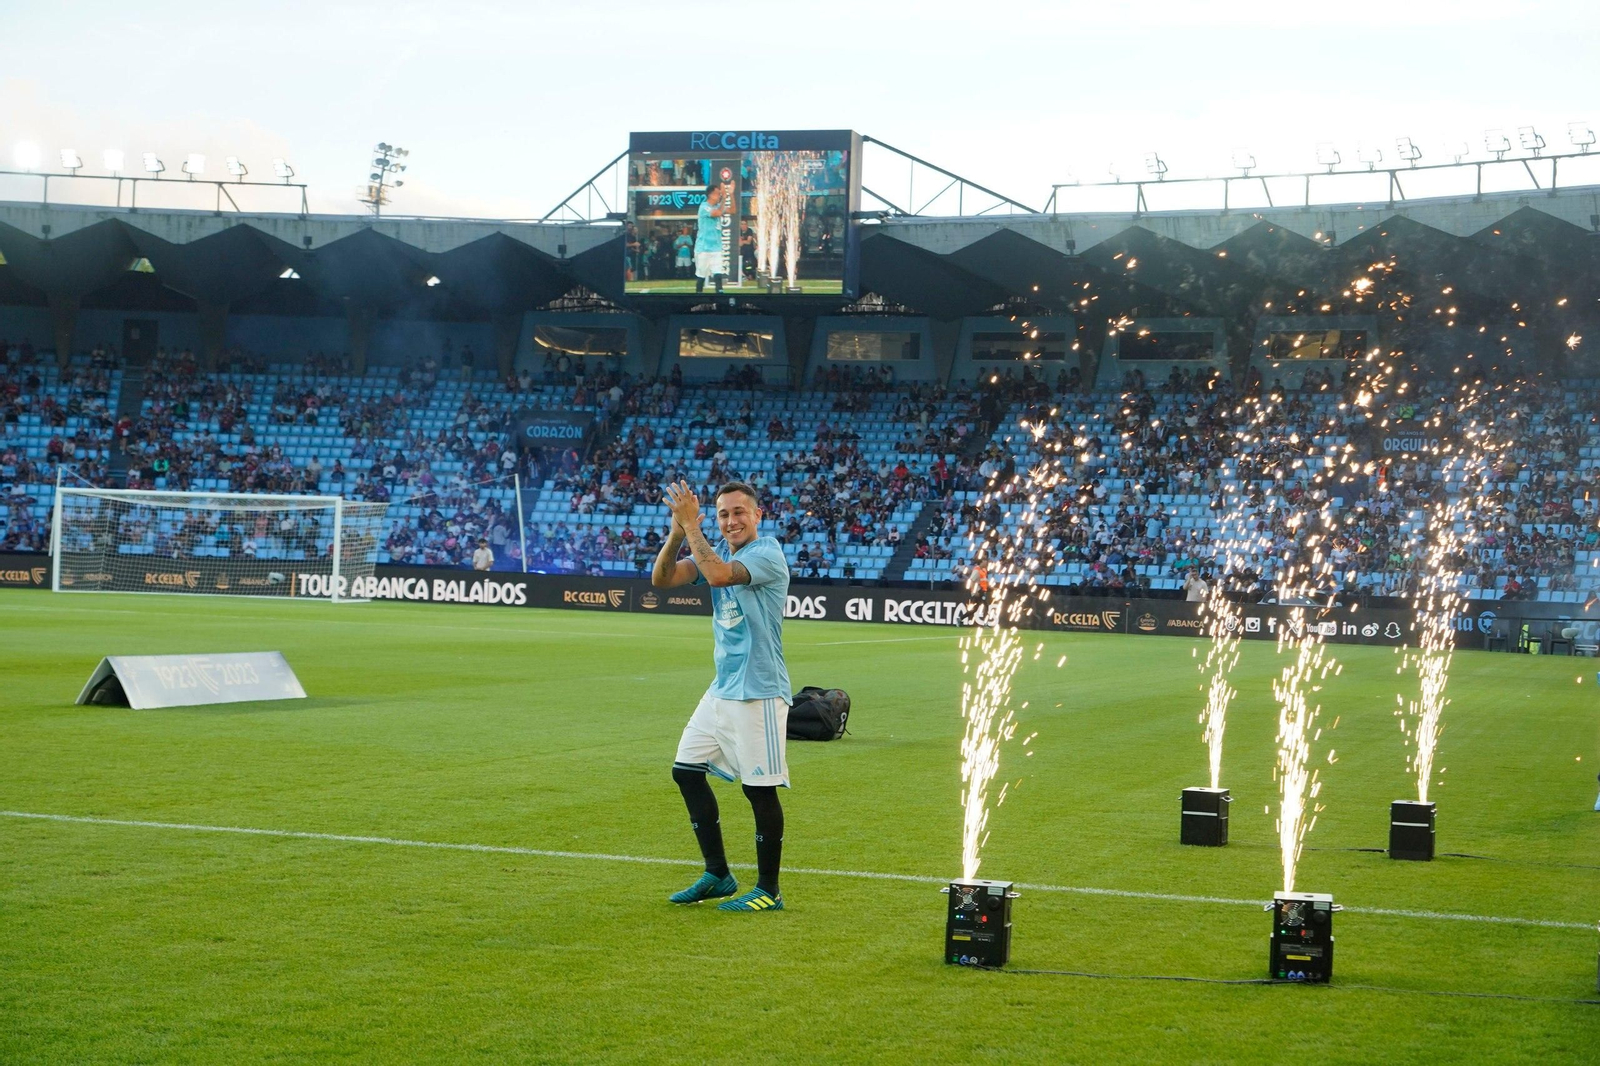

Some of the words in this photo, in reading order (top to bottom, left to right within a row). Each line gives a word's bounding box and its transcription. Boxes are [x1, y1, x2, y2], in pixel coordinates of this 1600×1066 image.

[648, 195, 672, 205] 1923
[687, 194, 706, 205] 202
[6, 570, 30, 581] CELTA
[144, 573, 157, 584] RC
[158, 574, 183, 586] CELTA
[299, 573, 347, 597] TOUR
[351, 576, 428, 600] ABANCA
[432, 578, 527, 605] BALAÍDOS
[564, 590, 578, 602] RC
[578, 591, 606, 604] CELTA
[845, 597, 873, 621] EN
[1053, 613, 1068, 625] RC
[1069, 613, 1100, 626] CELTA
[152, 664, 197, 690] 1923
[215, 662, 260, 685] 2023
